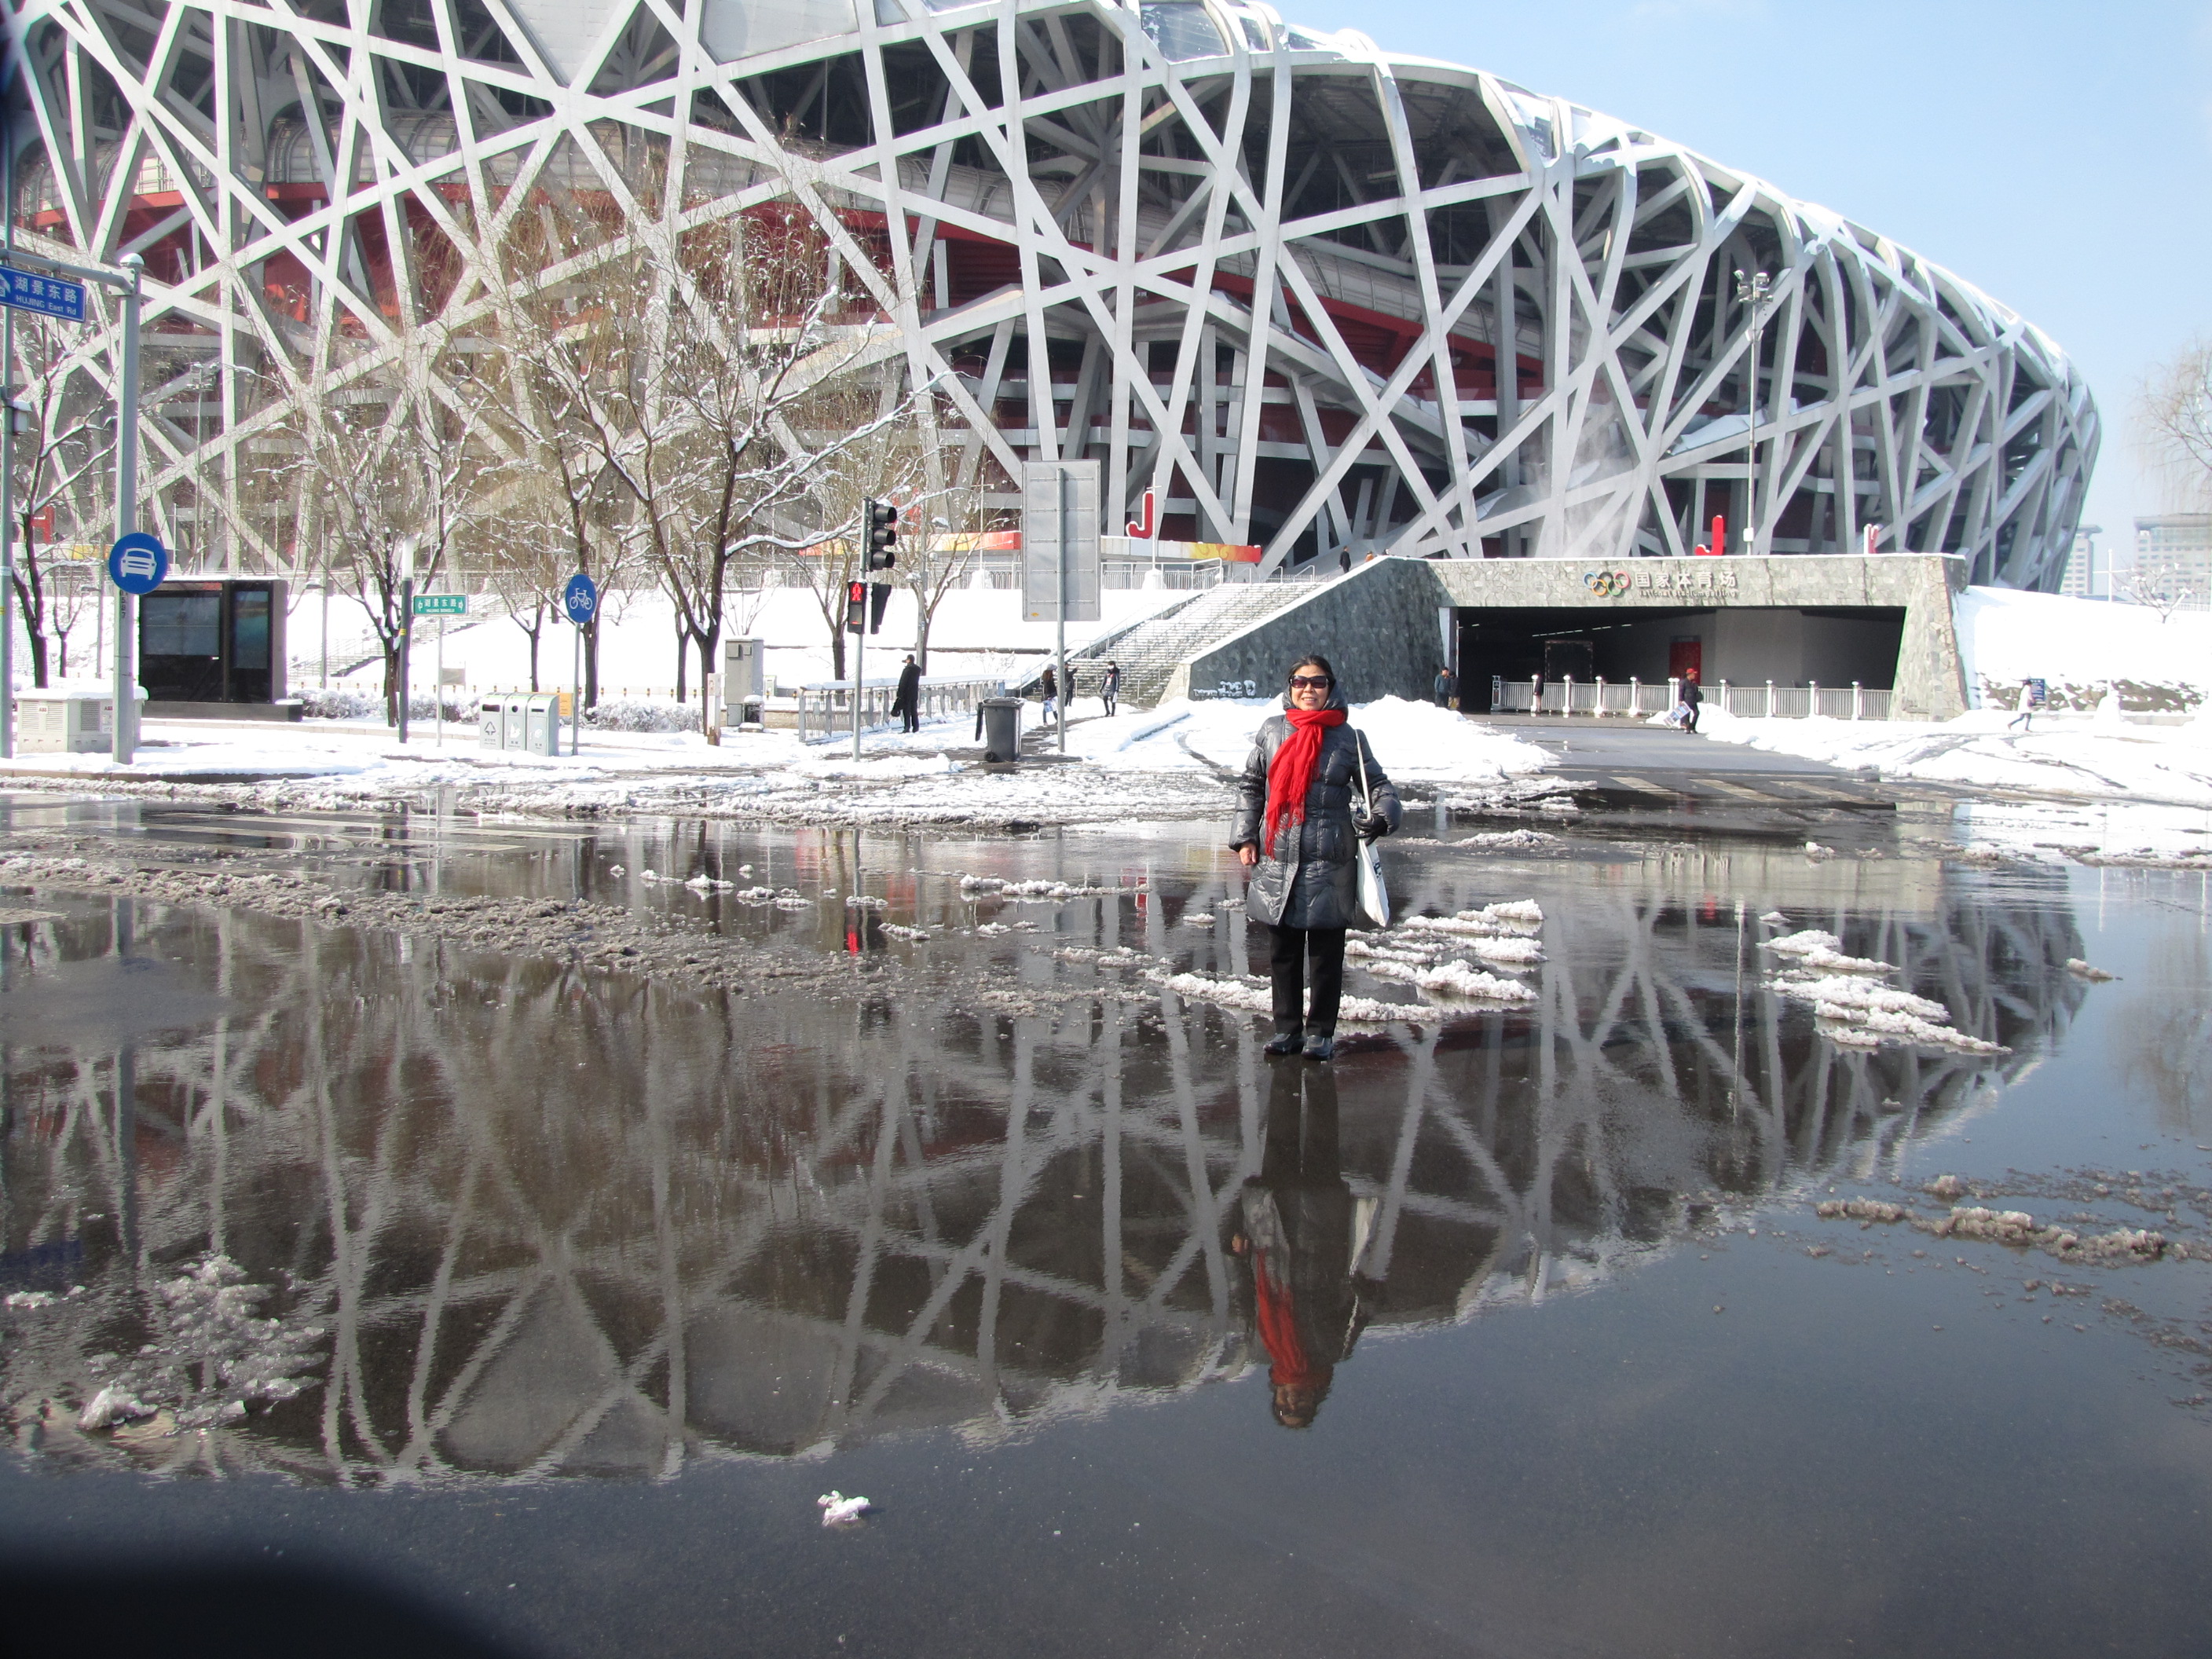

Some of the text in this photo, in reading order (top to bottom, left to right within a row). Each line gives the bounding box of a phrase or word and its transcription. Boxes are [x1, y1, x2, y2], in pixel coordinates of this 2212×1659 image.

[15, 276, 77, 303] 湖景东路
[16, 295, 77, 315] HUJING East Rd
[1635, 569, 1738, 588] 国家体育场
